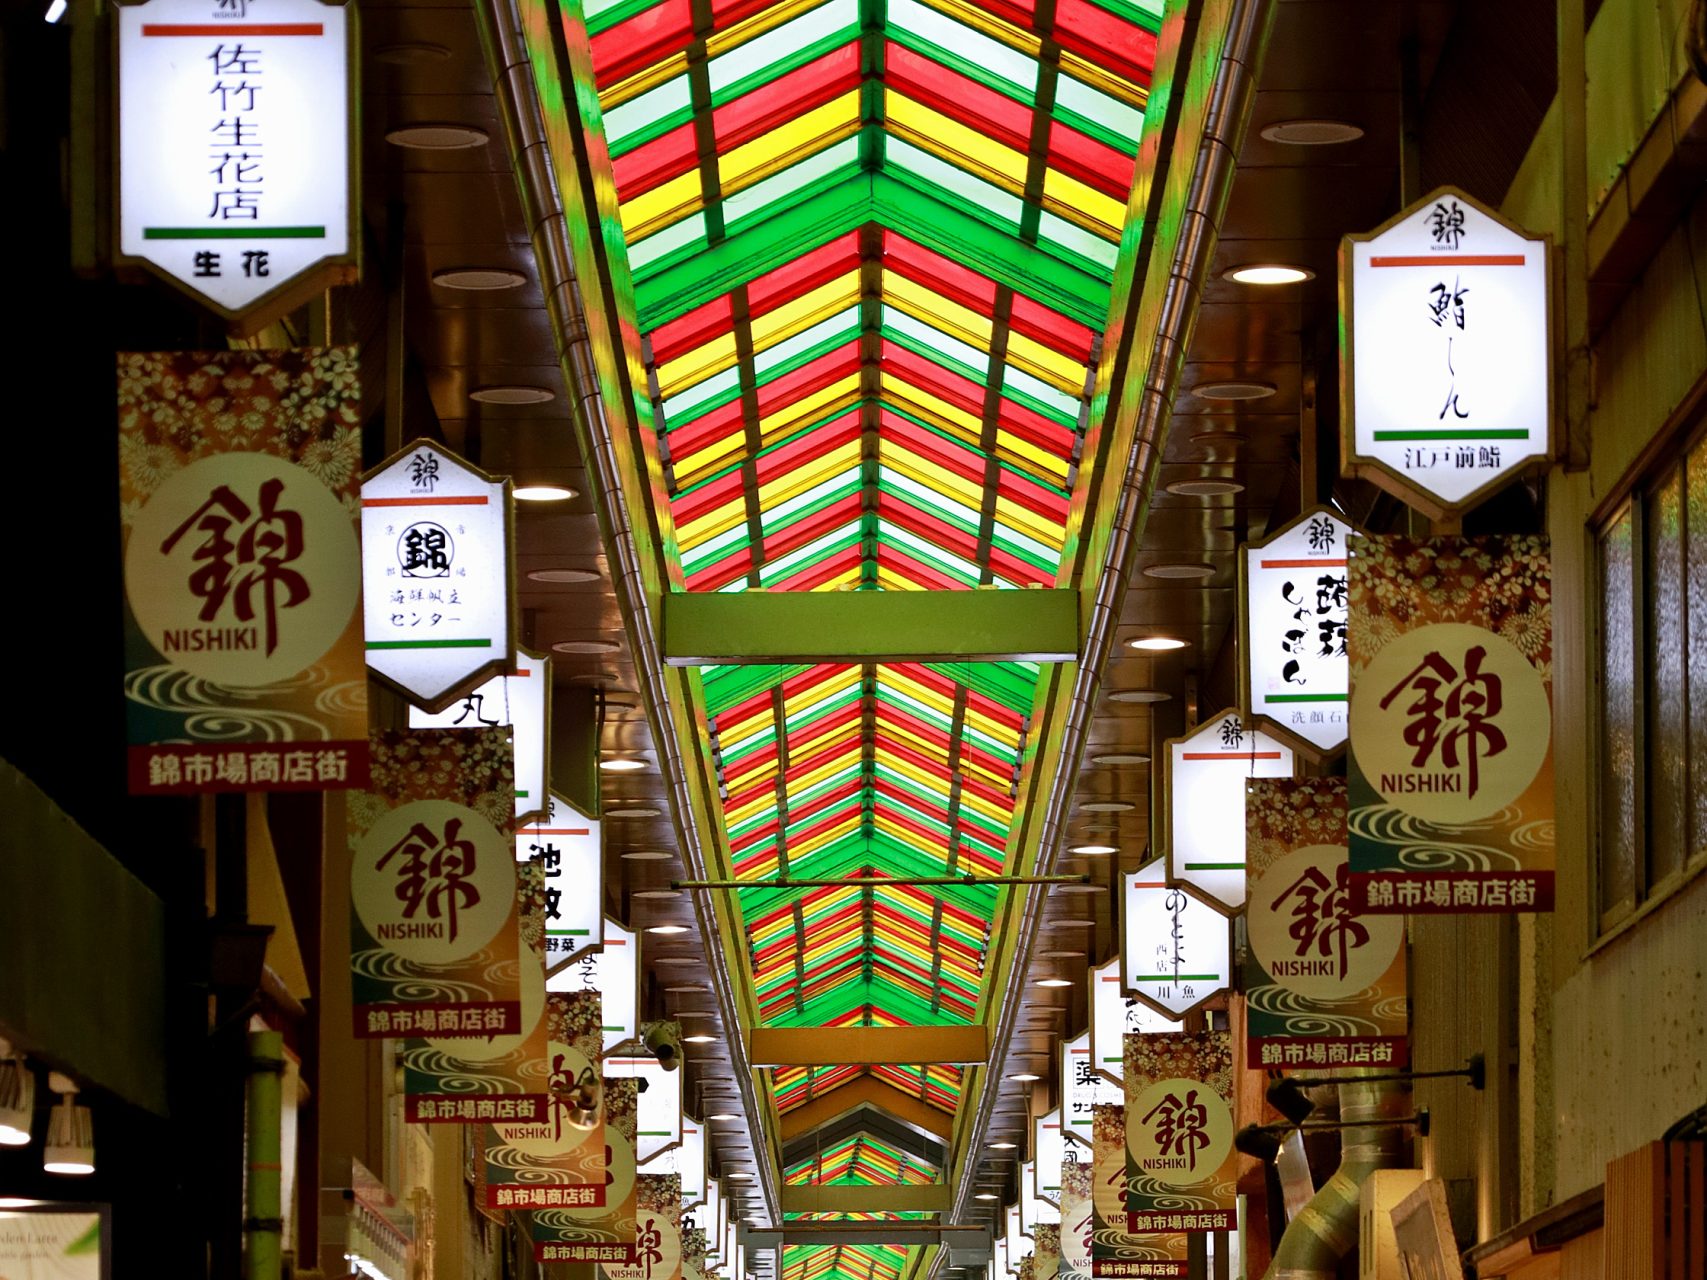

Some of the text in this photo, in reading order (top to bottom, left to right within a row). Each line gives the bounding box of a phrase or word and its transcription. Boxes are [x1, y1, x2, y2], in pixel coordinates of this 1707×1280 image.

[207, 43, 264, 221] 佐竹生花店
[193, 251, 270, 278] 生花
[1428, 274, 1470, 420] 鮨しん
[1405, 446, 1501, 469] 江戸前鮨
[160, 478, 311, 658] 錦
[391, 613, 461, 627] センター
[163, 629, 257, 652] NISHIKI
[1292, 711, 1348, 724] 洗顔石
[1379, 645, 1508, 800] 錦
[149, 750, 348, 786] 錦市場商店街
[1381, 774, 1461, 792] NISHIKI
[375, 818, 480, 944] 錦
[1367, 878, 1536, 907] 錦市場商店街
[377, 923, 443, 939] NISHIKI
[1272, 961, 1334, 976] NISHIKI
[1158, 986, 1195, 999] 川魚
[367, 1009, 506, 1033] 錦市場商店街
[1262, 1042, 1392, 1064] 錦市場商店街
[417, 1100, 535, 1119] 錦市場商店街
[504, 1128, 551, 1140] NISHIKI
[1142, 1090, 1210, 1172] 錦
[1143, 1159, 1186, 1169] NISHIKI
[496, 1188, 595, 1205] 錦市場商店街
[1137, 1215, 1227, 1230] 錦市場商店街
[543, 1246, 626, 1260] 錦市場商店街
[611, 1270, 644, 1279] NISHIKI
[1100, 1263, 1179, 1275] 錦市場商店街
